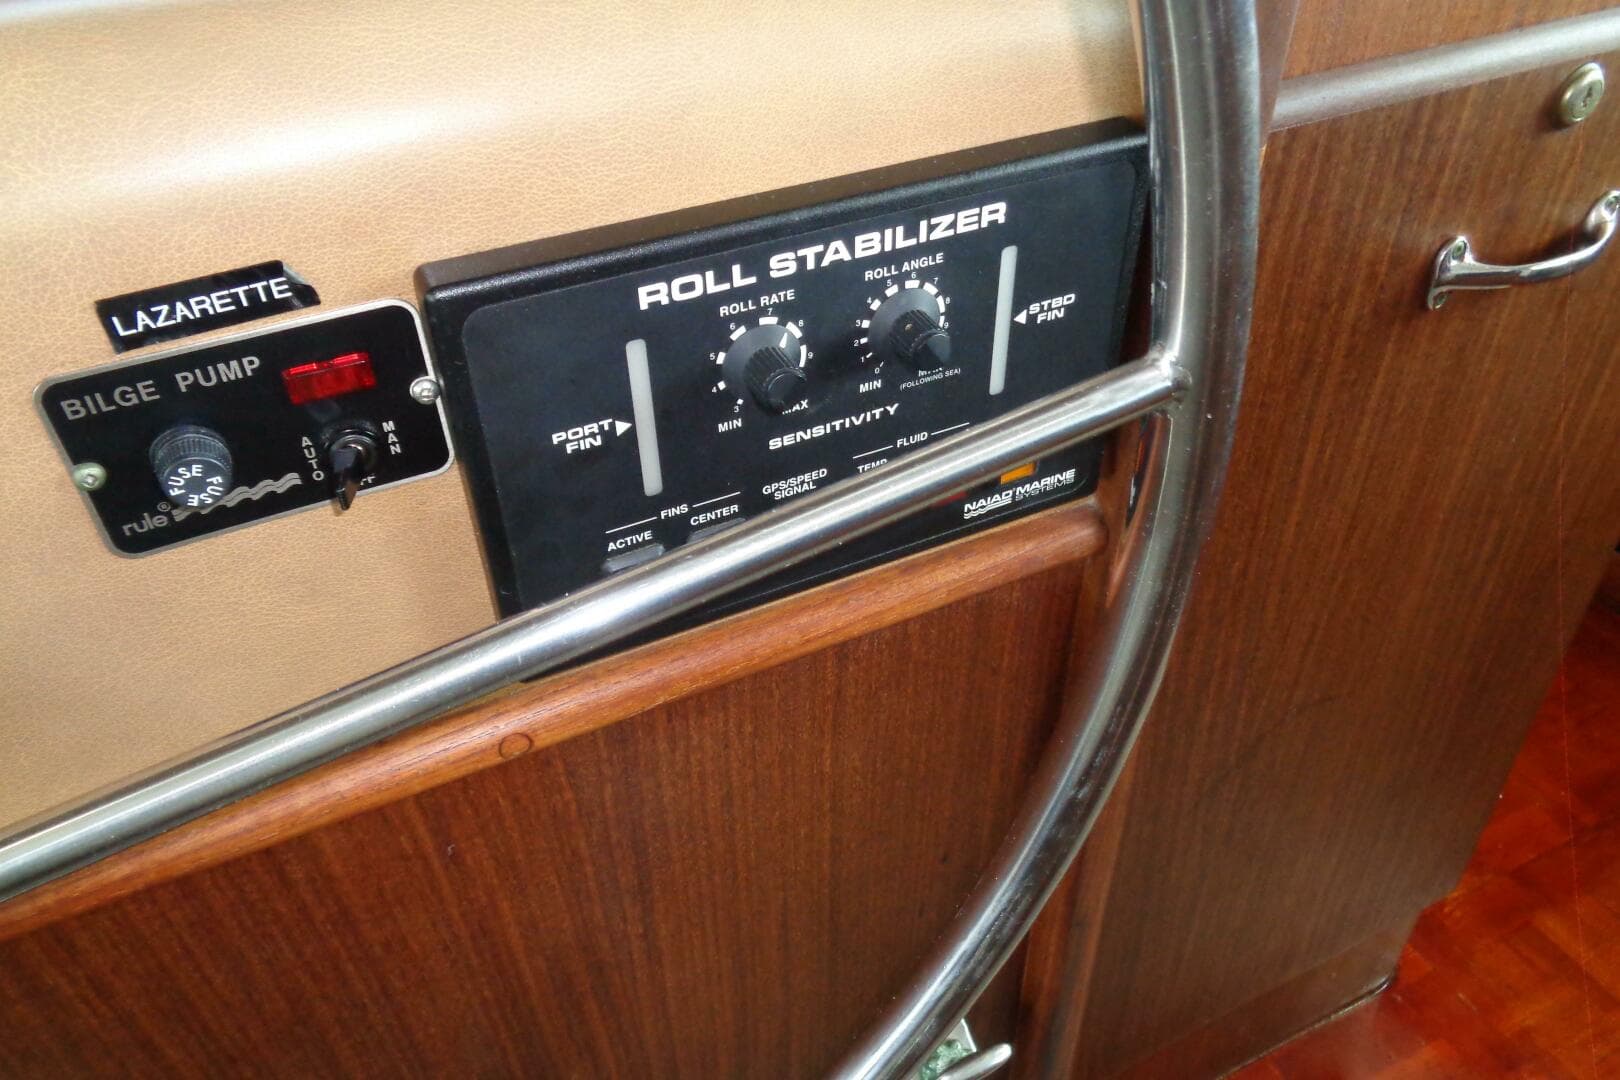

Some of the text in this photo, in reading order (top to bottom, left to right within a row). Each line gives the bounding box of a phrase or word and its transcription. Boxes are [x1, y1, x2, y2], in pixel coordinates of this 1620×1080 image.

[637, 201, 1007, 311] ROLL STABILIZER
[864, 252, 944, 281] ROLL ANGLE
[910, 271, 917, 279] 6
[886, 279, 893, 287] 5
[932, 277, 939, 285] 7
[111, 277, 293, 337] LAZARETTE
[719, 289, 796, 318] ROLL RATE
[866, 296, 872, 304] 4
[945, 297, 951, 305] 8
[1028, 293, 1076, 315] STBD
[767, 307, 774, 316] 7
[1036, 307, 1065, 324] FIN
[729, 322, 736, 330] 6
[798, 319, 804, 327] 8
[853, 339, 859, 347] 2
[709, 352, 716, 360] 5
[807, 352, 814, 360] 9
[60, 356, 261, 421] BILGE PUMP
[859, 379, 882, 394] MIN
[733, 405, 740, 413] 3
[781, 398, 809, 415] AX
[551, 418, 613, 445] PORT
[717, 418, 743, 433] MIN
[768, 403, 899, 450] SENSITIVITY
[382, 420, 402, 455] MAN
[565, 435, 602, 455] FIN
[896, 431, 929, 448] FLUID
[301, 436, 325, 481] AUTO
[167, 464, 204, 497] FUSE
[762, 468, 828, 495] GPS/SPEED
[1015, 476, 1075, 501] SYSTEMS
[186, 475, 225, 507] FUSE
[774, 482, 817, 500] SIGNAL
[963, 468, 1077, 513] NAIAD MARINE
[660, 503, 689, 520] FINS
[689, 504, 740, 527] CENTER
[607, 530, 654, 552] ACTIVE
